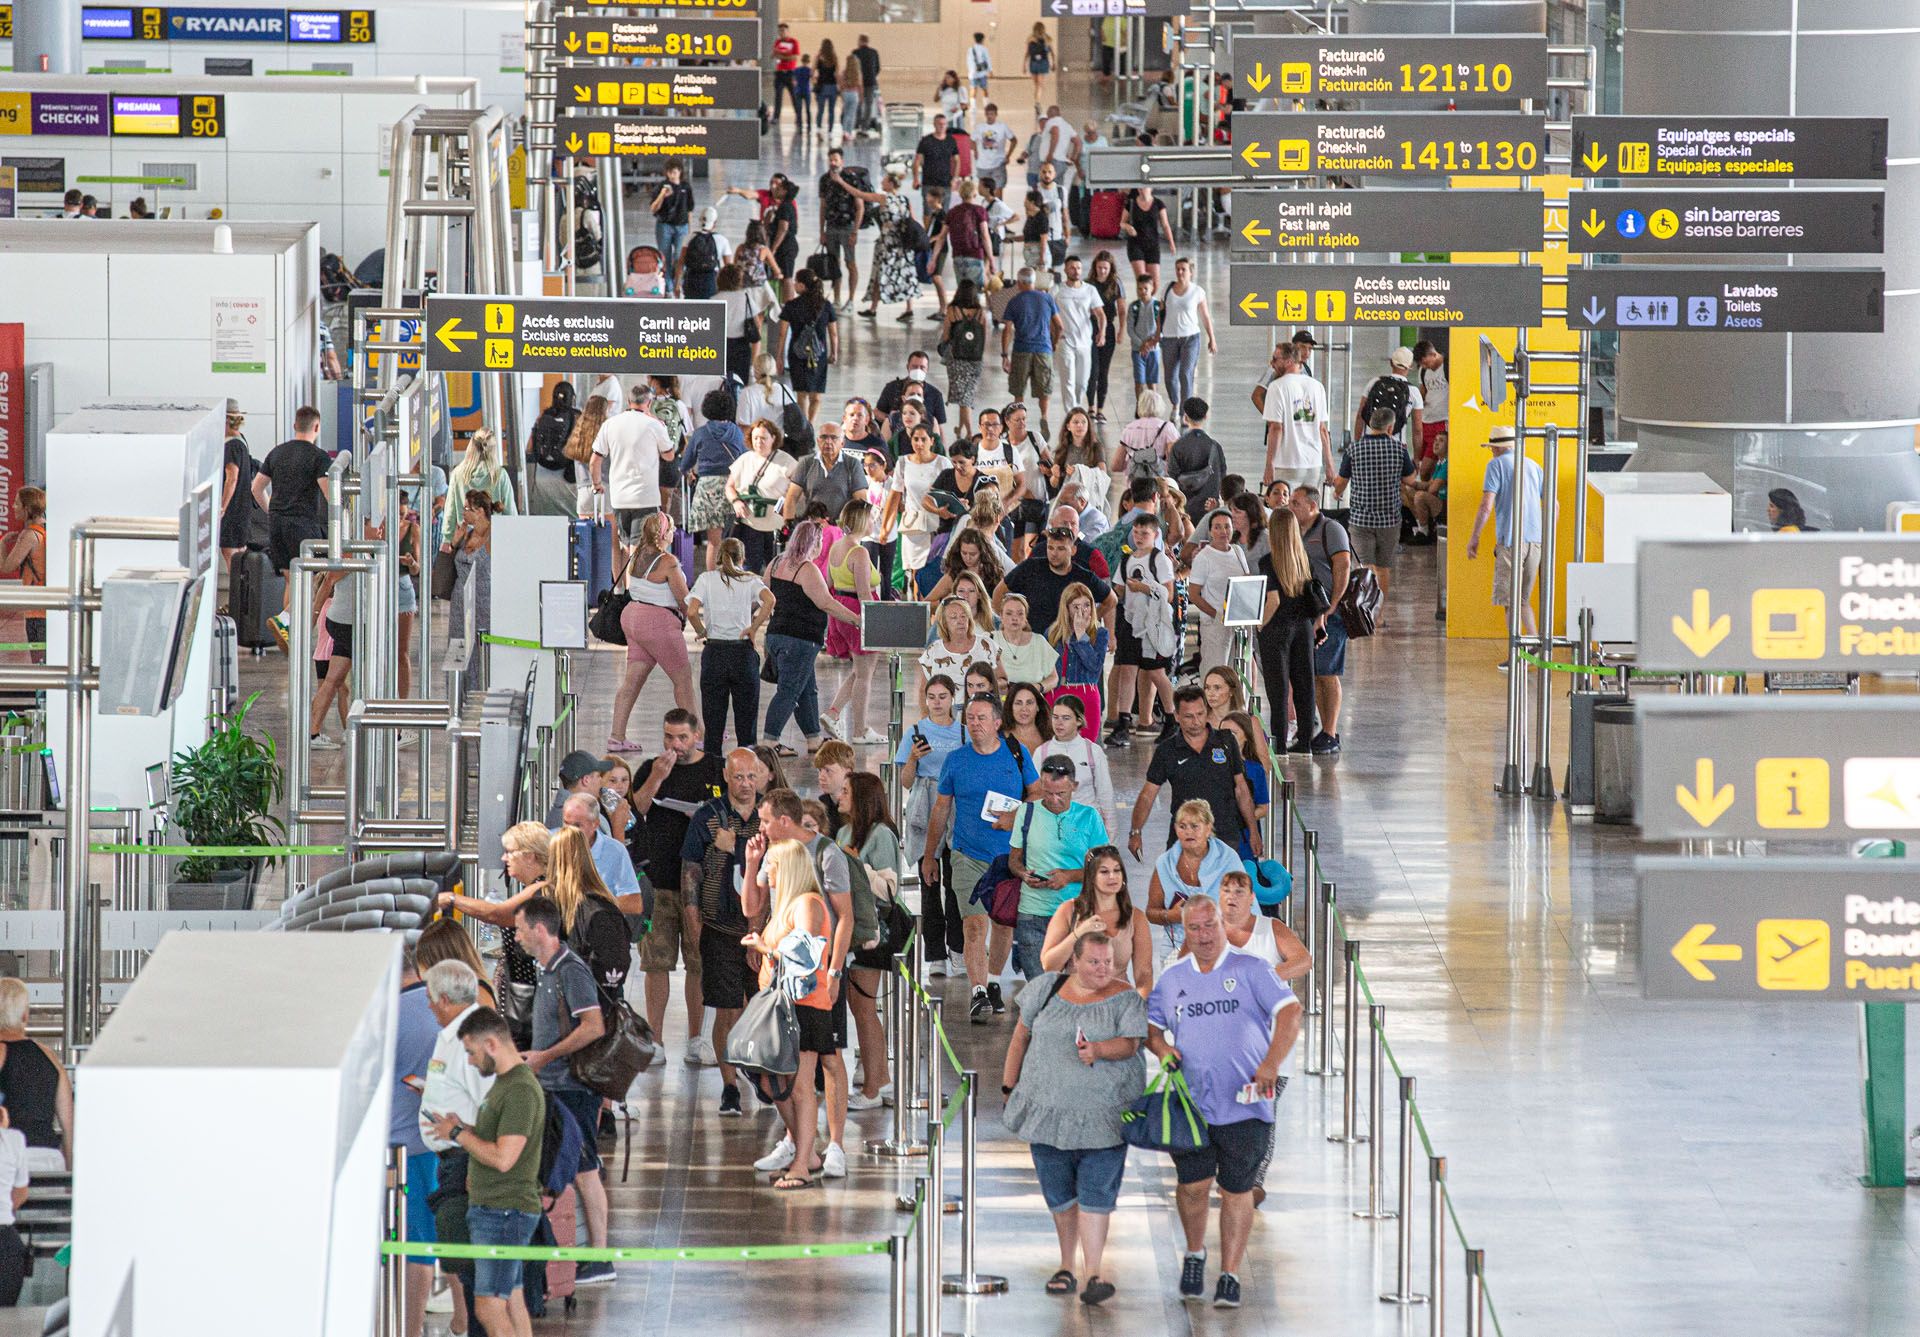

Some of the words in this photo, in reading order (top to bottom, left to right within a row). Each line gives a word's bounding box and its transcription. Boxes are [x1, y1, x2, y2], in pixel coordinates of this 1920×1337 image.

[186, 16, 282, 33] RYANAIR
[143, 25, 161, 39] 51
[349, 28, 370, 42] 50
[665, 34, 693, 55] 81
[703, 34, 732, 55] 10
[1318, 48, 1385, 62] Facturació
[1318, 65, 1367, 76] Check-in
[1400, 63, 1456, 92] 121
[1458, 64, 1470, 76] to
[1473, 63, 1512, 92] 10
[673, 74, 717, 85] Arribades
[1318, 78, 1393, 92] Facturación
[117, 102, 161, 112] PREMIUM
[40, 113, 99, 124] CHECK-IN
[192, 119, 219, 137] 90
[1317, 125, 1385, 139] Facturació
[1658, 129, 1730, 143] Equipatges
[1734, 129, 1795, 143] especials
[1317, 142, 1367, 153] Check-in
[1658, 145, 1698, 158] Special
[1701, 145, 1752, 157] Check-in
[1317, 155, 1393, 169] Facturación
[1400, 141, 1458, 170] 141
[1460, 141, 1472, 153] to
[1476, 141, 1537, 170] 130
[1657, 159, 1721, 173] Equipajes
[1725, 159, 1794, 173] especiales
[1278, 203, 1314, 216] Carril
[1318, 202, 1352, 218] ràpid
[1685, 207, 1709, 221] sin
[1712, 207, 1780, 222] barreras
[1279, 219, 1303, 230] Fast
[1306, 219, 1330, 230] lane
[1685, 226, 1733, 237] sense
[1736, 224, 1804, 237] barreres
[1278, 233, 1314, 246] Carril
[1318, 233, 1360, 248] rápido
[1354, 276, 1393, 290] Accés
[1397, 277, 1451, 290] exclusiu
[1724, 284, 1778, 298] Lavabos
[1353, 292, 1404, 305] Exclusive
[1407, 295, 1445, 305] access
[1724, 300, 1761, 312] Toilets
[1354, 308, 1400, 321] Acceso
[1404, 308, 1464, 321] exclusivo
[1724, 315, 1763, 328] Aseos
[522, 315, 560, 329] Accés
[563, 315, 614, 330] exclusiu
[639, 316, 674, 330] Carril
[677, 316, 711, 332] ràpid
[521, 330, 570, 343] Exclusive
[573, 332, 609, 343] access
[639, 331, 662, 343] Fast
[664, 332, 687, 344] lane
[522, 345, 566, 358] Acceso
[570, 345, 628, 359] exclusivo
[639, 346, 674, 359] Carril
[677, 346, 717, 361] rápido
[1187, 999, 1240, 1018] SBOTOP
